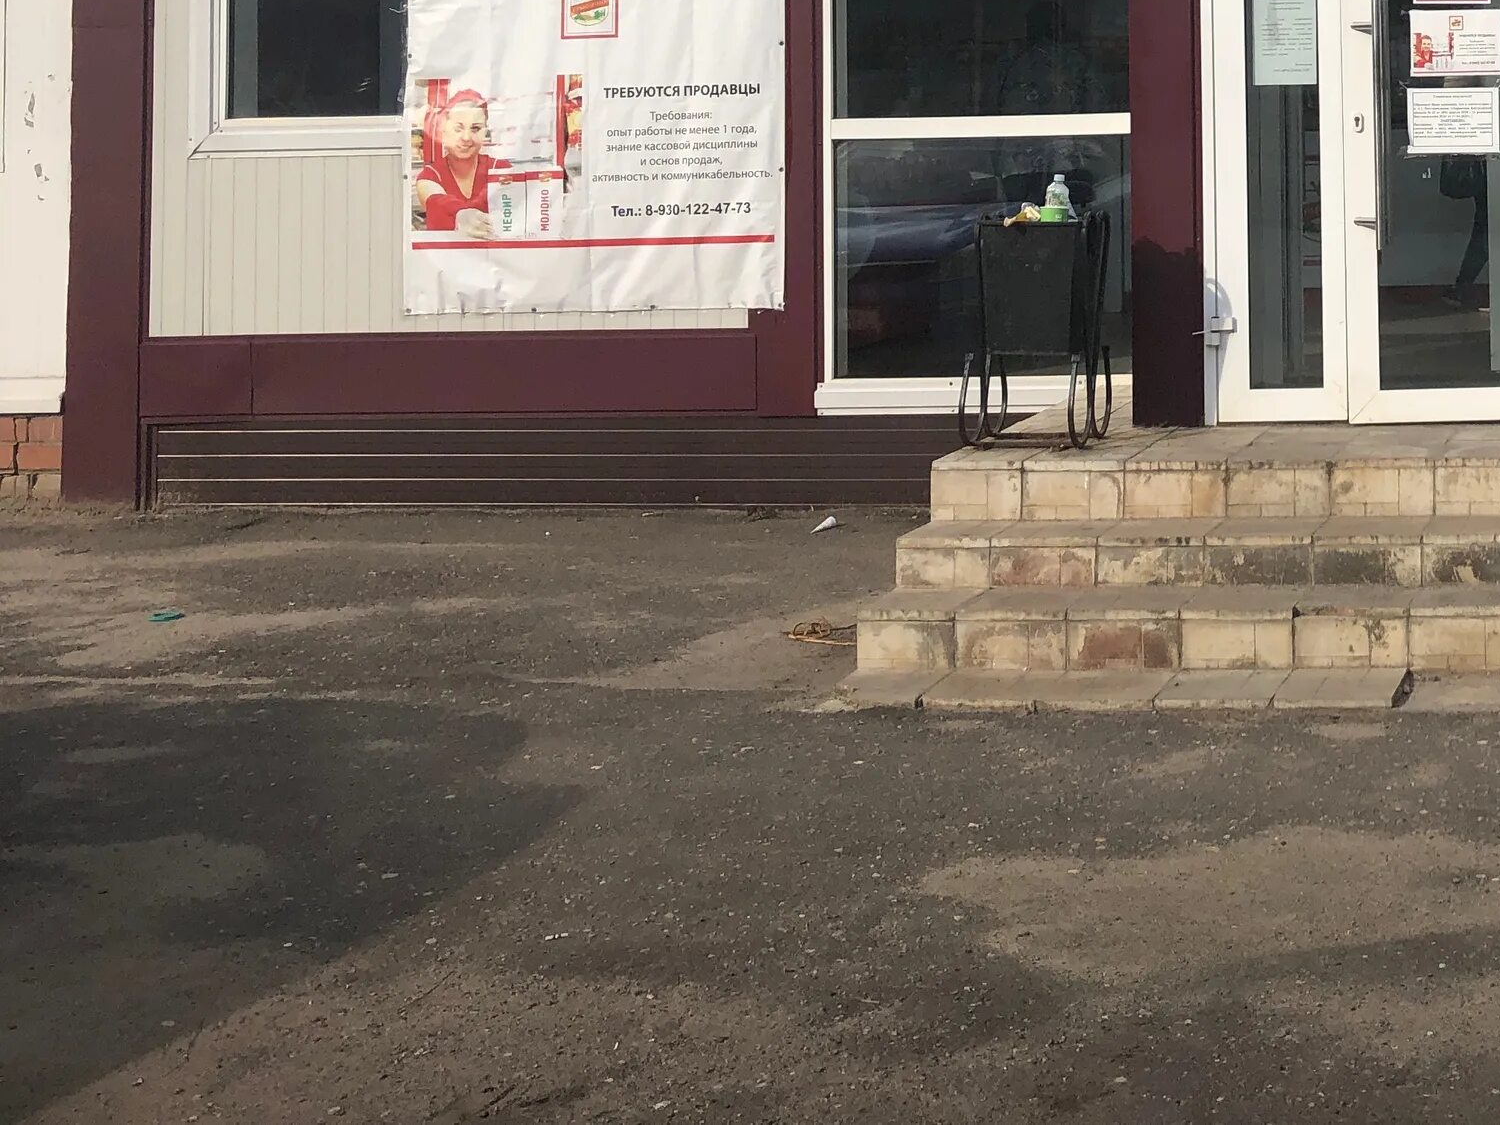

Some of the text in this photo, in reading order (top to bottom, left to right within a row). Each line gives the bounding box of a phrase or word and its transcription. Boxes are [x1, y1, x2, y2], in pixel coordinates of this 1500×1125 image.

[603, 83, 761, 99] ТРЕБУЮТСЯ ПРОДАВЦЫ
[649, 111, 713, 122] Требования:
[606, 129, 632, 138] опыт
[635, 126, 672, 138] работы
[675, 127, 687, 135] не
[689, 126, 720, 135] менее
[731, 125, 757, 136] года,
[606, 140, 758, 152] знание кассовой дисциплины
[640, 156, 723, 167] и основ продаж,
[592, 170, 773, 183] активность и коммуникабельность.
[540, 189, 550, 232] МОЛОКО
[611, 202, 751, 217] Тел.: 8-930-122-47-73
